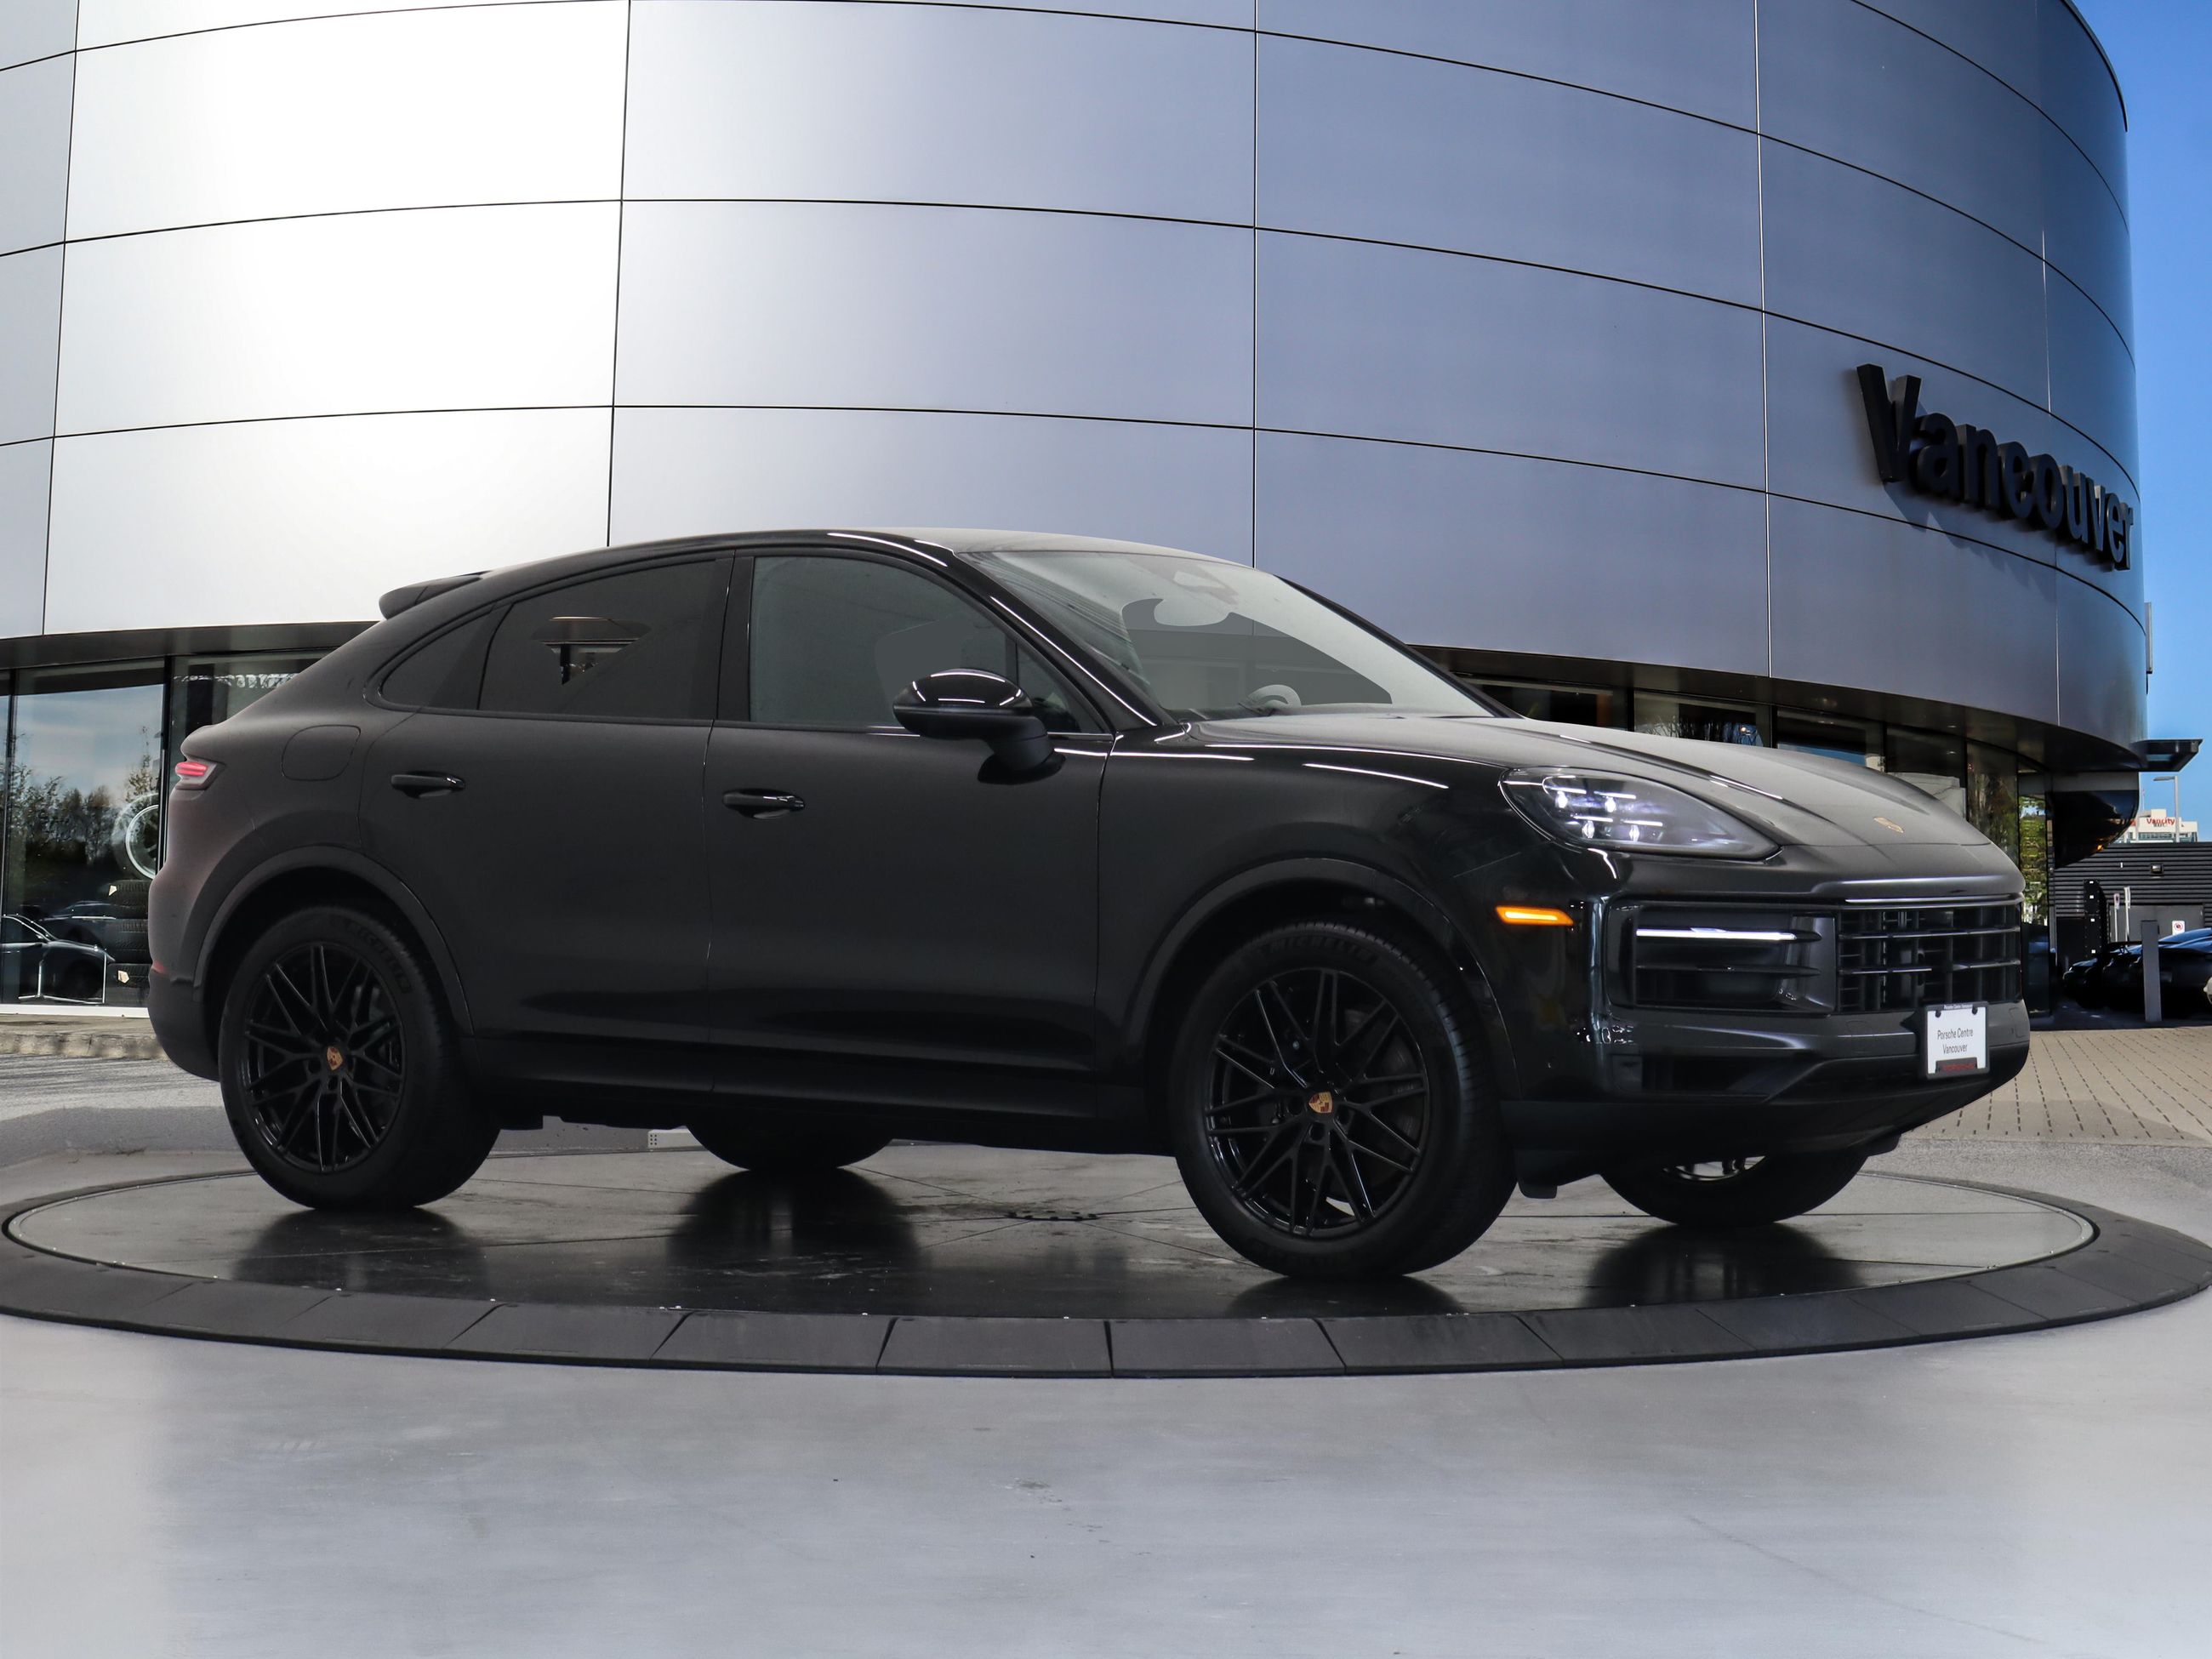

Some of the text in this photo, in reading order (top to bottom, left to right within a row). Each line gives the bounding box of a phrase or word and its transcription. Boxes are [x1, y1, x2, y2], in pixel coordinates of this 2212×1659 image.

[1857, 363, 2134, 571] Vancouver
[1937, 1028, 1973, 1040] Porsche Centre
[1942, 1044, 1968, 1054] Vancouver
